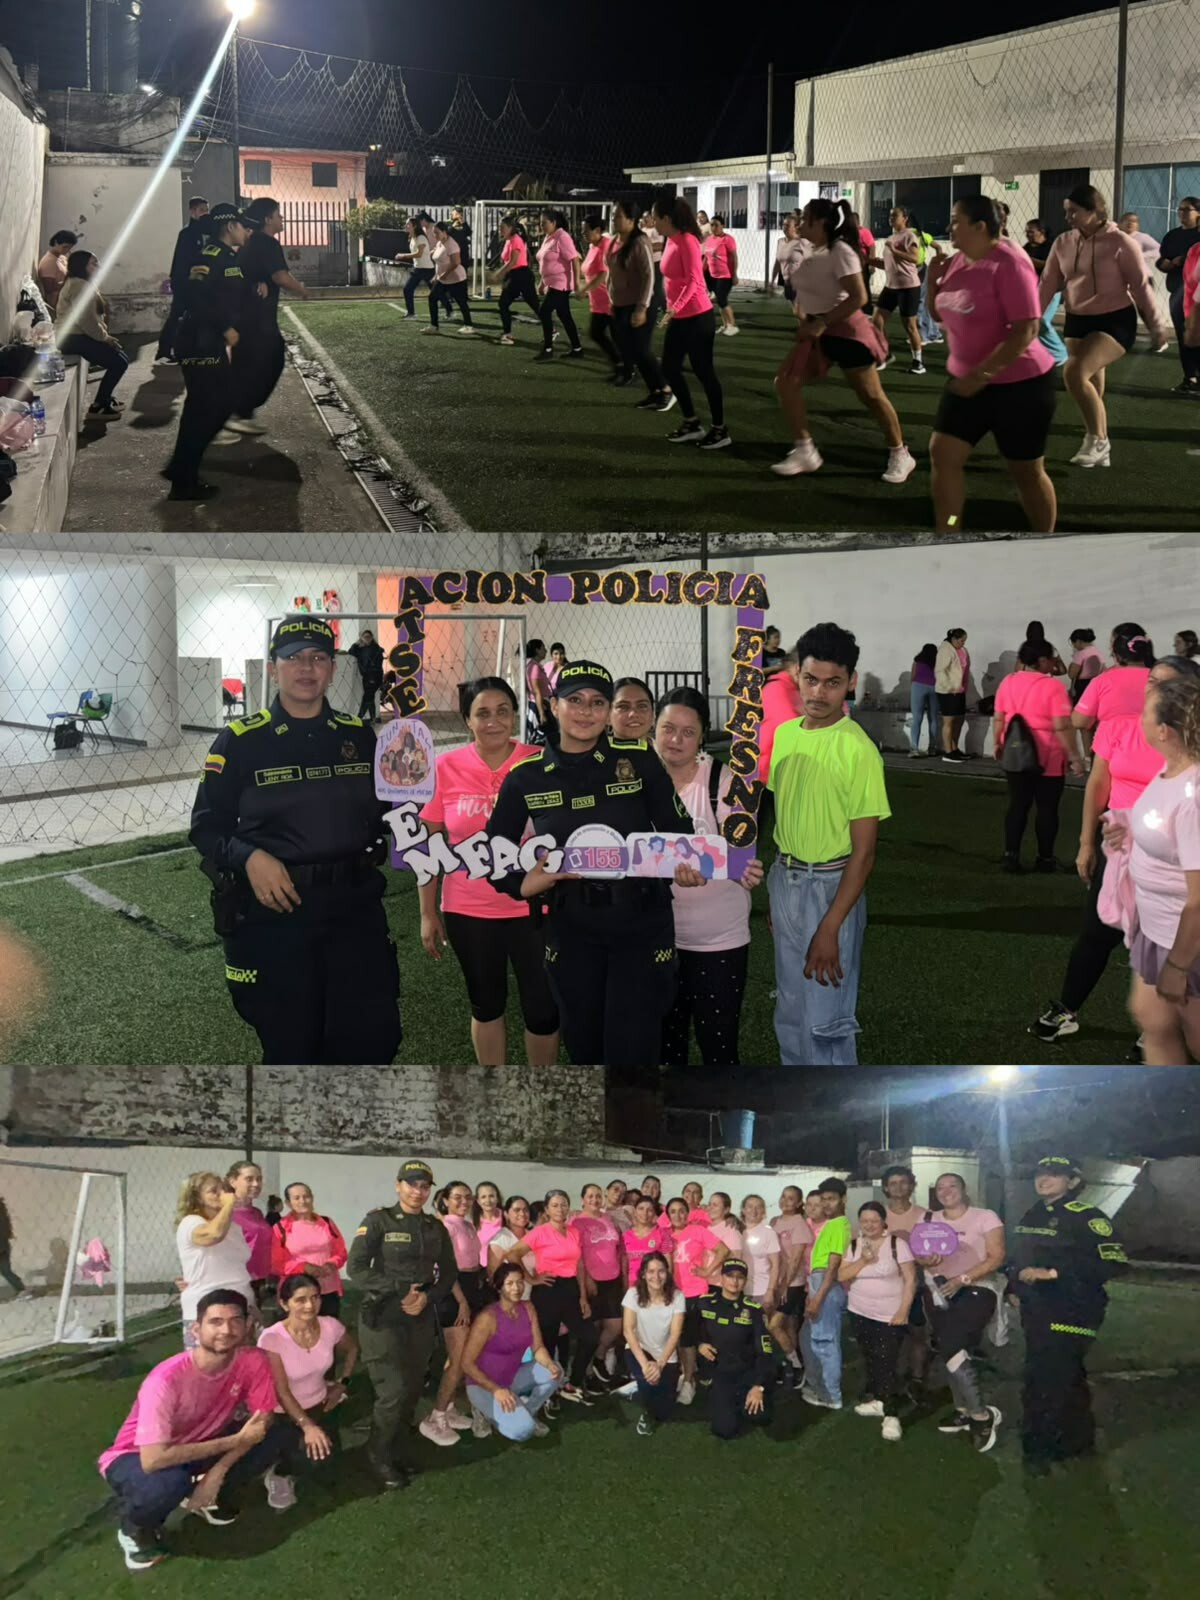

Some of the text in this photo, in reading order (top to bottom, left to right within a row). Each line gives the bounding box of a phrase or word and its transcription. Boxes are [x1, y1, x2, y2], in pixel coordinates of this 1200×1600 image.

[569, 569, 770, 611] POLICIA
[722, 625, 767, 848] FRESNO
[584, 847, 621, 868] 155
